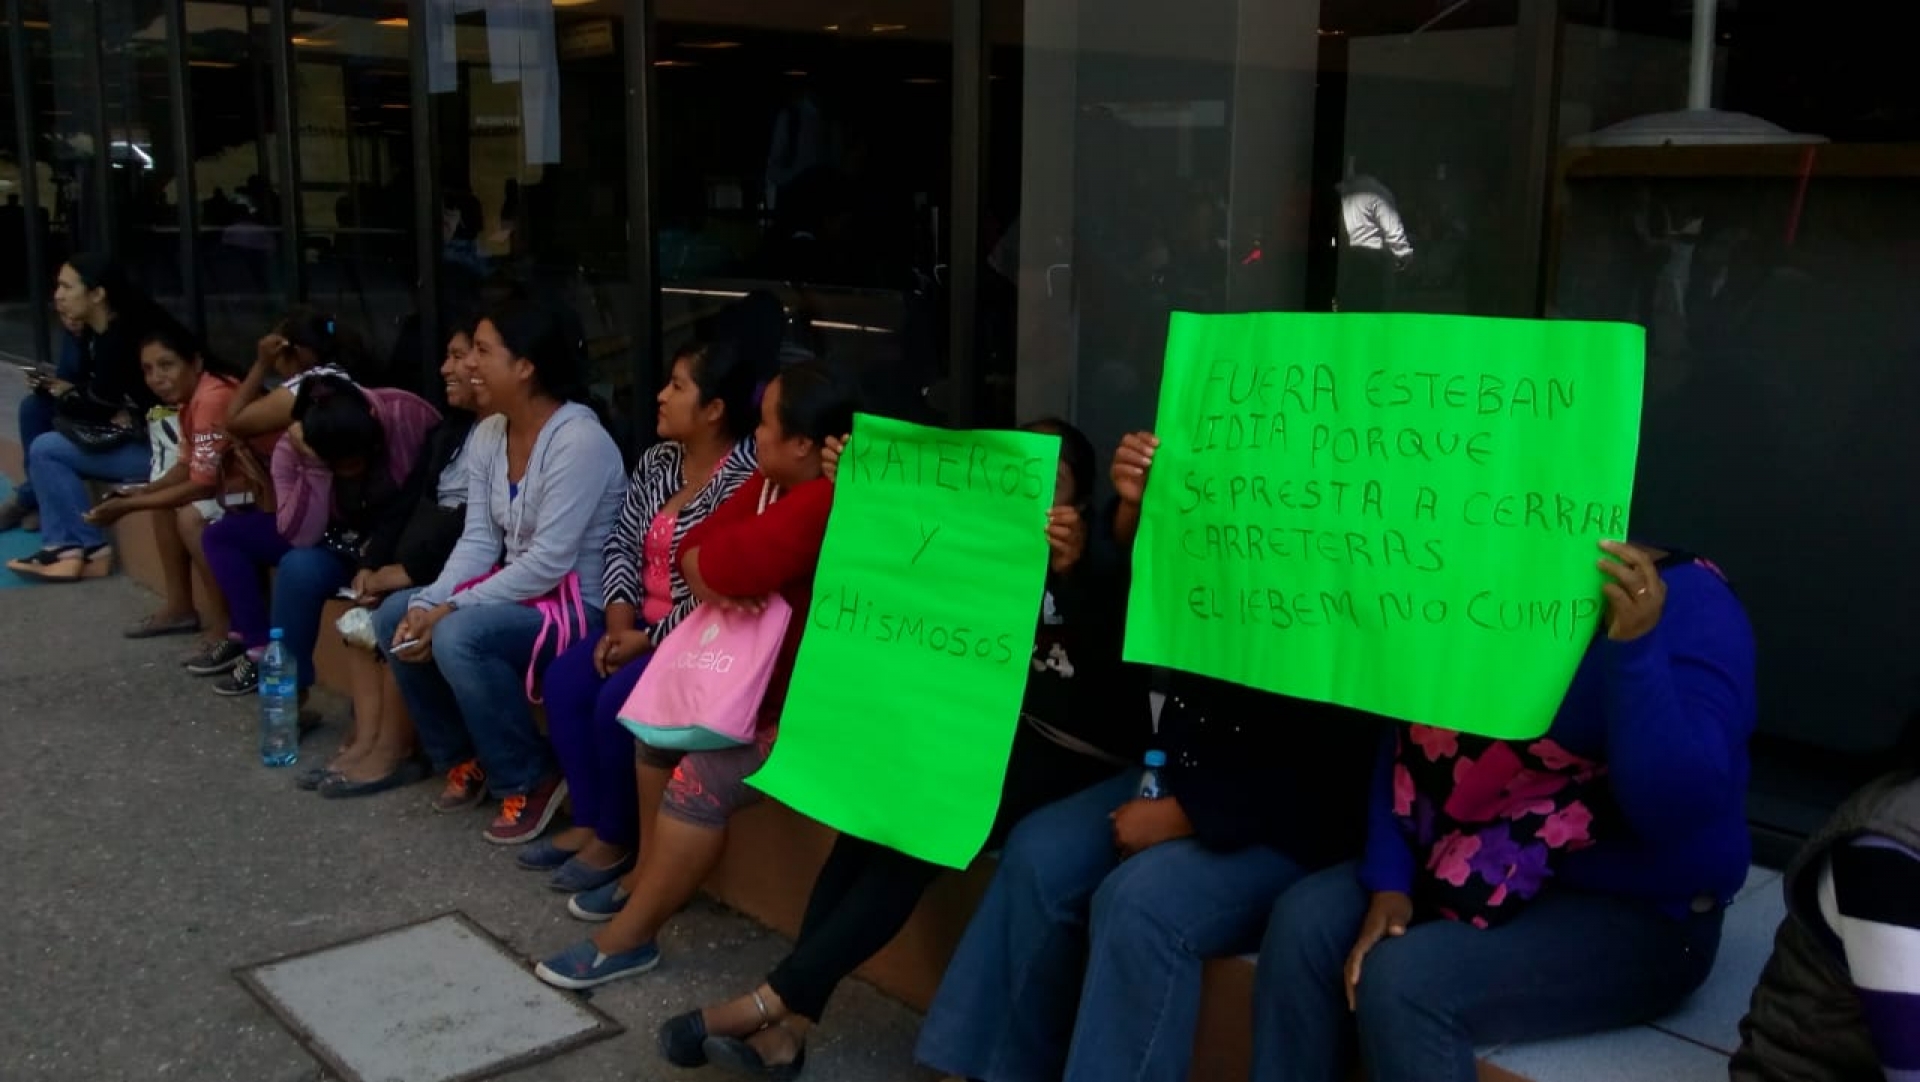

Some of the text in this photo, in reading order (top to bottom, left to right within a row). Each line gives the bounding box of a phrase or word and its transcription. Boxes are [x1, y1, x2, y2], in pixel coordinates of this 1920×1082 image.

[1200, 360, 1576, 418] FUERA ESTEBAN
[1191, 411, 1492, 467] LIDIA PORQUE
[1414, 487, 1438, 522] A
[911, 521, 940, 565] Y
[1181, 523, 1446, 572] CARRETERAS
[1187, 586, 1224, 620] EL
[1378, 591, 1448, 627] NO
